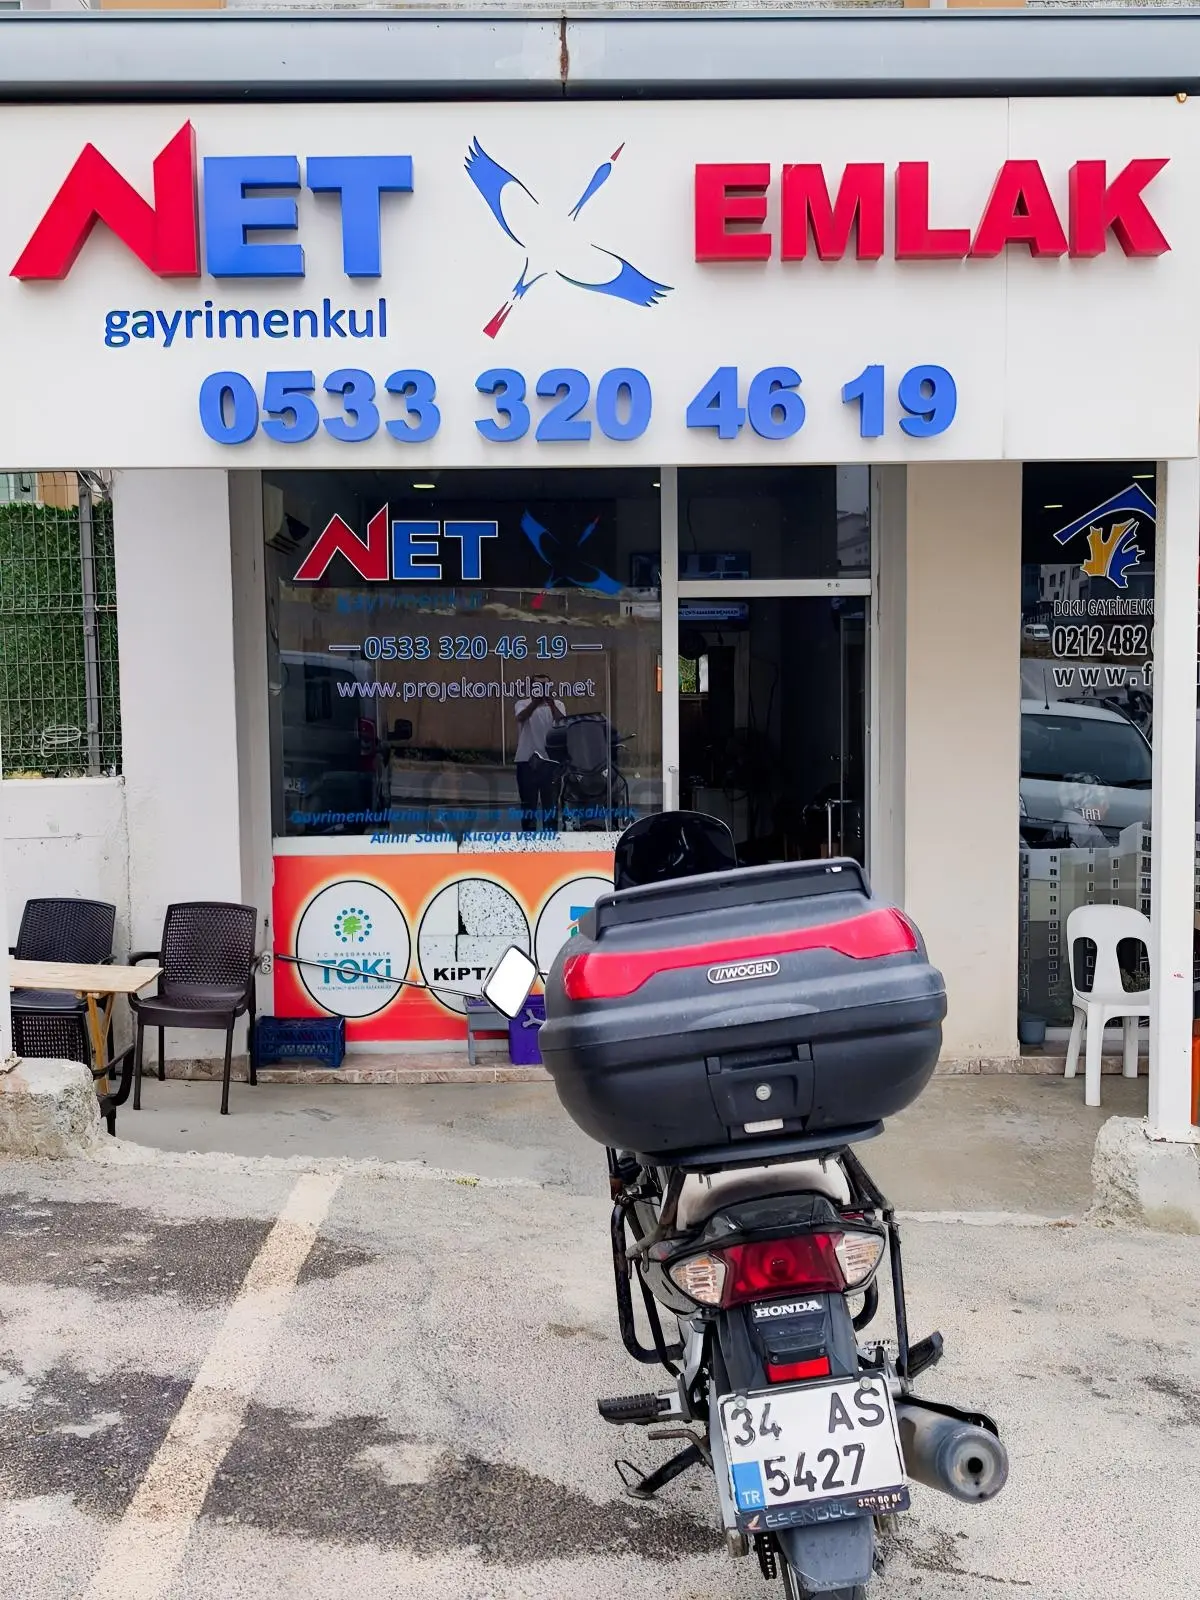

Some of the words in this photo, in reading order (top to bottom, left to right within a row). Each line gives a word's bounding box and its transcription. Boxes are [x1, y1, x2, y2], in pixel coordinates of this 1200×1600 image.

[9, 118, 414, 280] NET
[695, 158, 1172, 263] EMLAK
[104, 298, 387, 348] gayrimenkul
[199, 368, 442, 444] 0533
[475, 368, 652, 442] 320
[686, 366, 806, 440] 46
[842, 364, 958, 438] 19
[293, 502, 498, 581] NET
[1054, 600, 1086, 616] DOKU
[364, 636, 430, 659] 0533
[439, 636, 488, 659] 320
[494, 636, 528, 658] 46
[536, 635, 568, 658] 19
[1053, 626, 1104, 657] 0212
[1108, 625, 1147, 656] 482
[337, 677, 595, 702] www.projekonutlar.net
[755, 1300, 823, 1319] HONDA
[731, 1403, 783, 1447] 34
[829, 1389, 885, 1434] AS
[764, 1443, 866, 1497] 5427
[742, 1490, 761, 1505] TR
